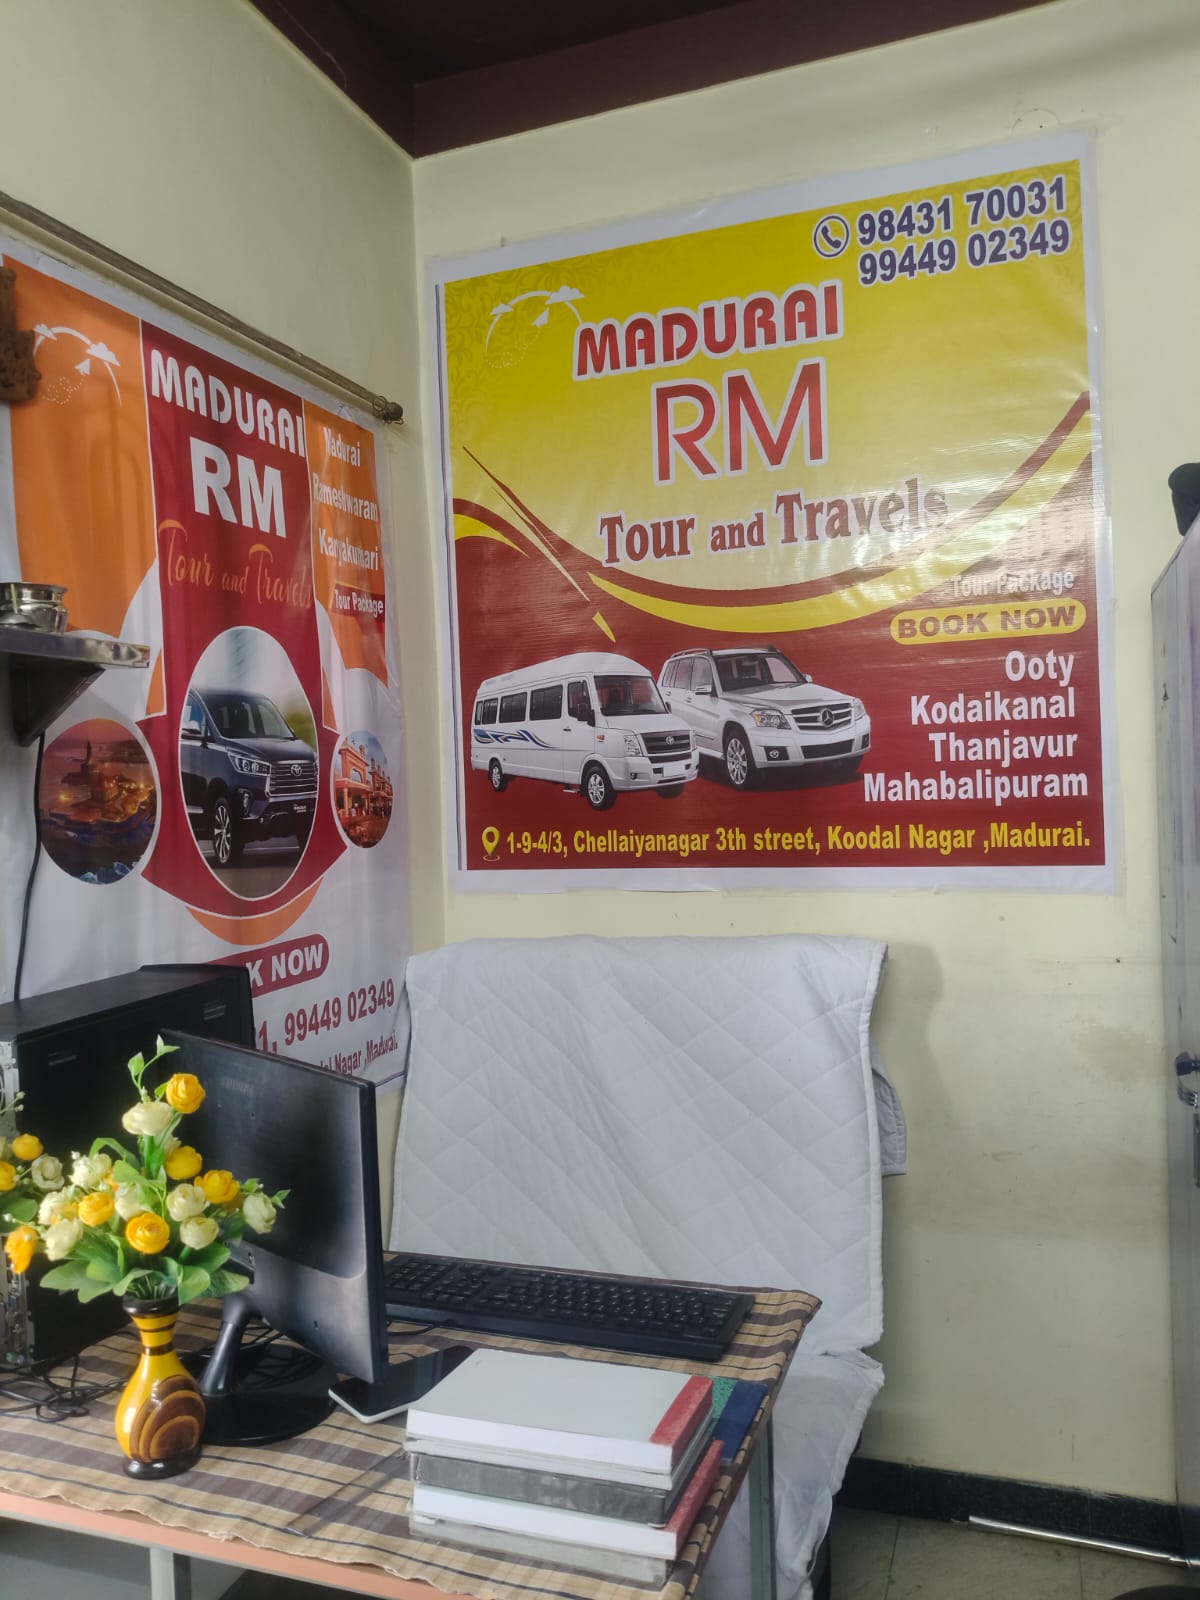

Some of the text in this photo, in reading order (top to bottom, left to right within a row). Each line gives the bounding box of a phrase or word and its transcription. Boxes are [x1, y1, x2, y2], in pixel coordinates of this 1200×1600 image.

[857, 175, 1066, 246] 98431 70031
[858, 218, 1071, 286] 99449 02349
[575, 281, 843, 379] MADURAI
[149, 348, 306, 458] MADURAI
[652, 357, 827, 484] RM
[189, 436, 287, 538] RM
[312, 472, 379, 521] Rameshwaram
[599, 478, 949, 567] Tour and Travels
[158, 519, 313, 609] Tour and Travels
[318, 527, 379, 571] Kanyakumari
[334, 588, 384, 617] Tour Package
[950, 570, 1075, 597] Tour Package
[898, 605, 1076, 639] BOOK NOW
[1004, 650, 1075, 686] Ooty
[910, 690, 1076, 725] Kodaikanal
[928, 730, 1079, 767] Thanjavur
[863, 770, 1089, 806] Mahabalipuram
[506, 822, 1092, 859] 1-9-4/3, Chellaiyanagar 3th street, Koodal Nagar ,Madurai.
[271, 943, 323, 982] NOW
[284, 997, 341, 1046] 99449
[347, 978, 395, 1022] 02349
[335, 1050, 362, 1076] Nagar
